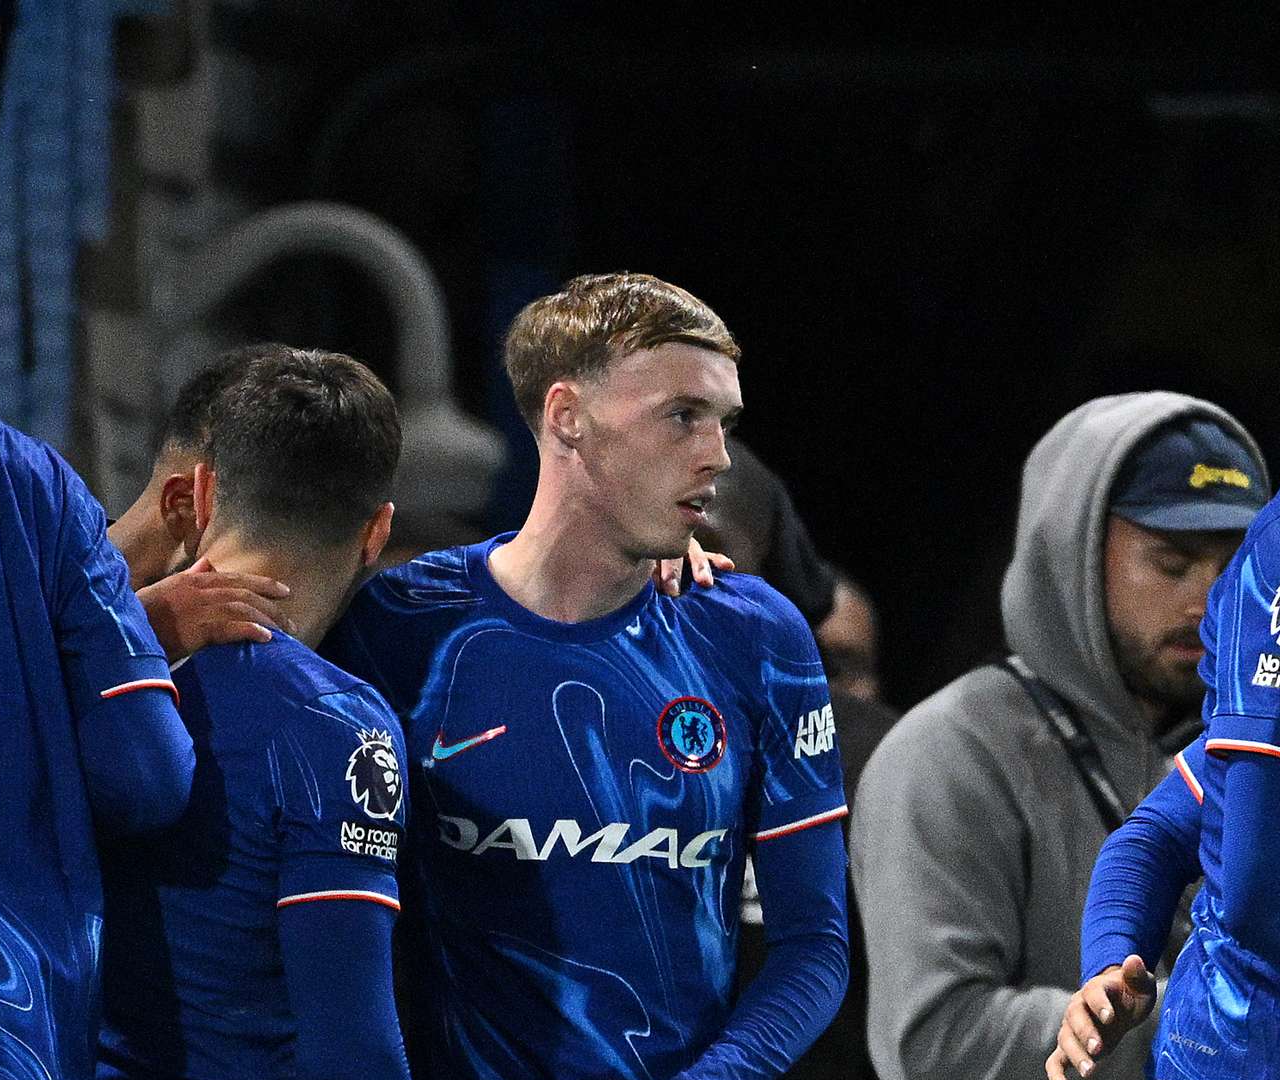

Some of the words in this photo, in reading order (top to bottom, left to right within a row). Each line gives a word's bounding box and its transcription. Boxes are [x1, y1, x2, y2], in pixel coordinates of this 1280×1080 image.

[1259, 653, 1280, 674] No
[340, 821, 366, 841] No
[367, 828, 398, 846] room
[436, 814, 728, 870] DAMAC
